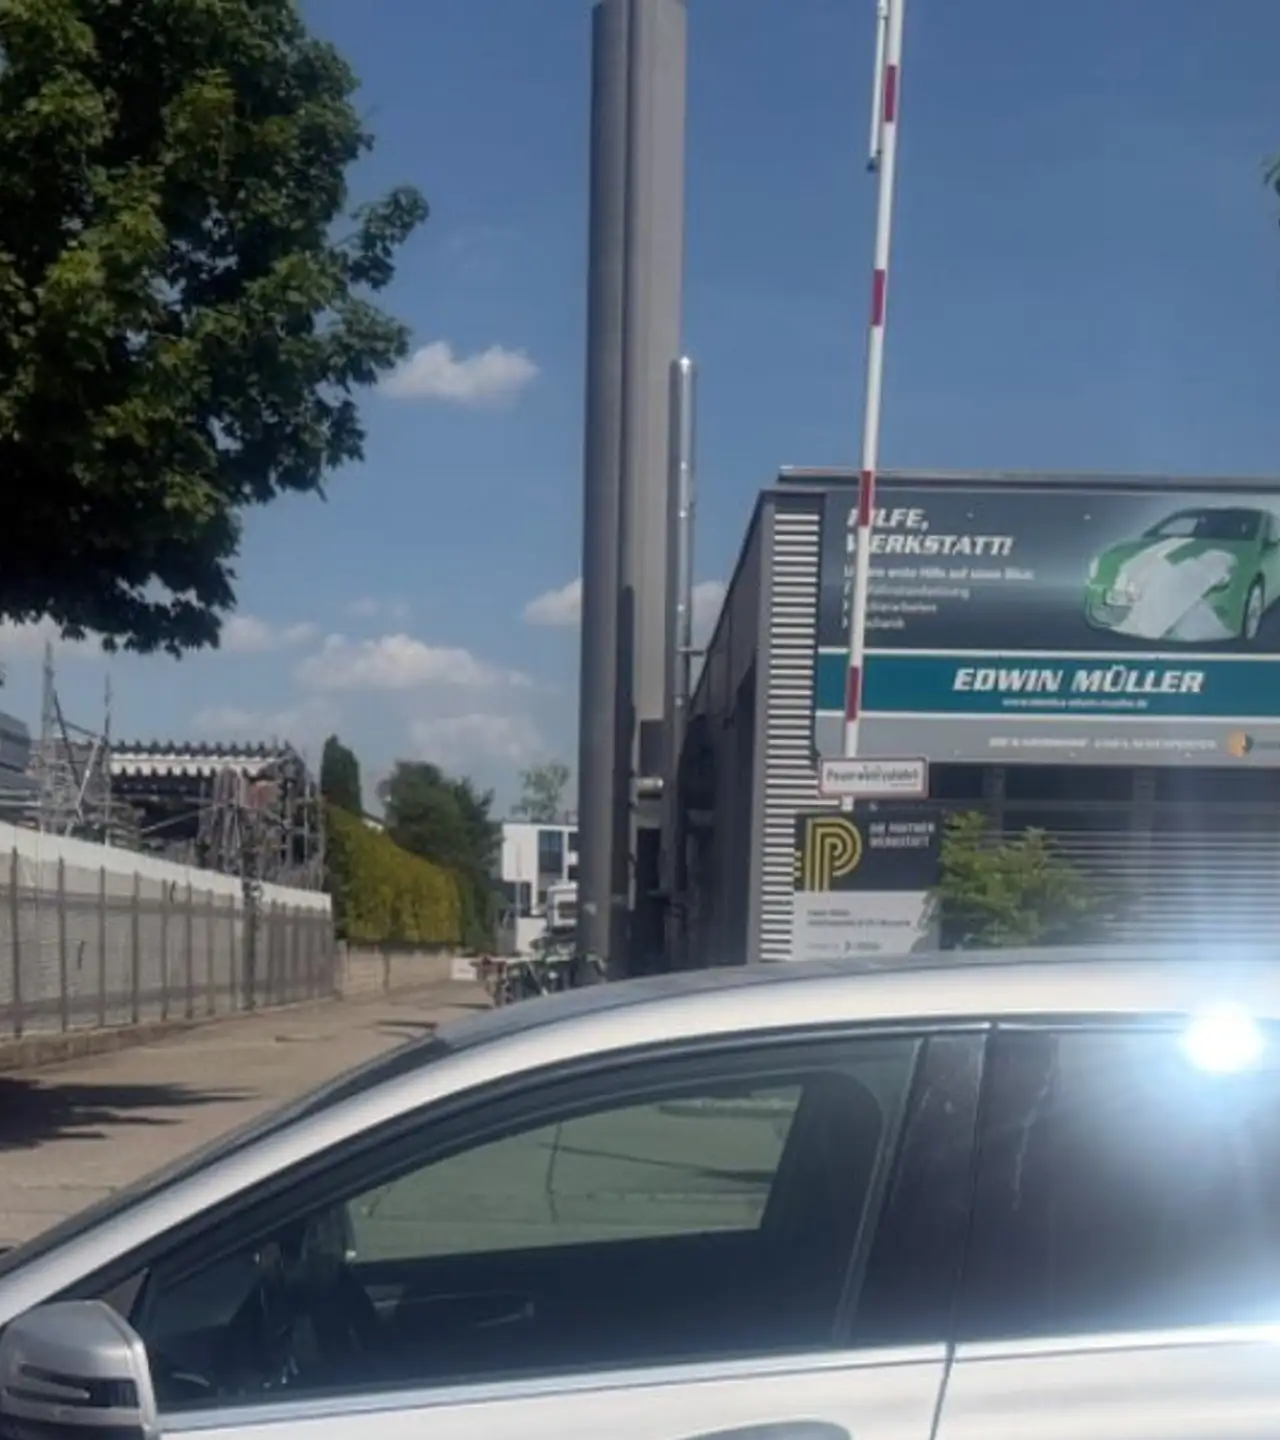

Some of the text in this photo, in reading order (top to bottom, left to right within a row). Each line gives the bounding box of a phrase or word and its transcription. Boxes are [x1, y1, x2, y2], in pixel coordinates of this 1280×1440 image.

[847, 508, 929, 532] HLFE,
[952, 664, 1204, 693] EDWIN MÜLLER
